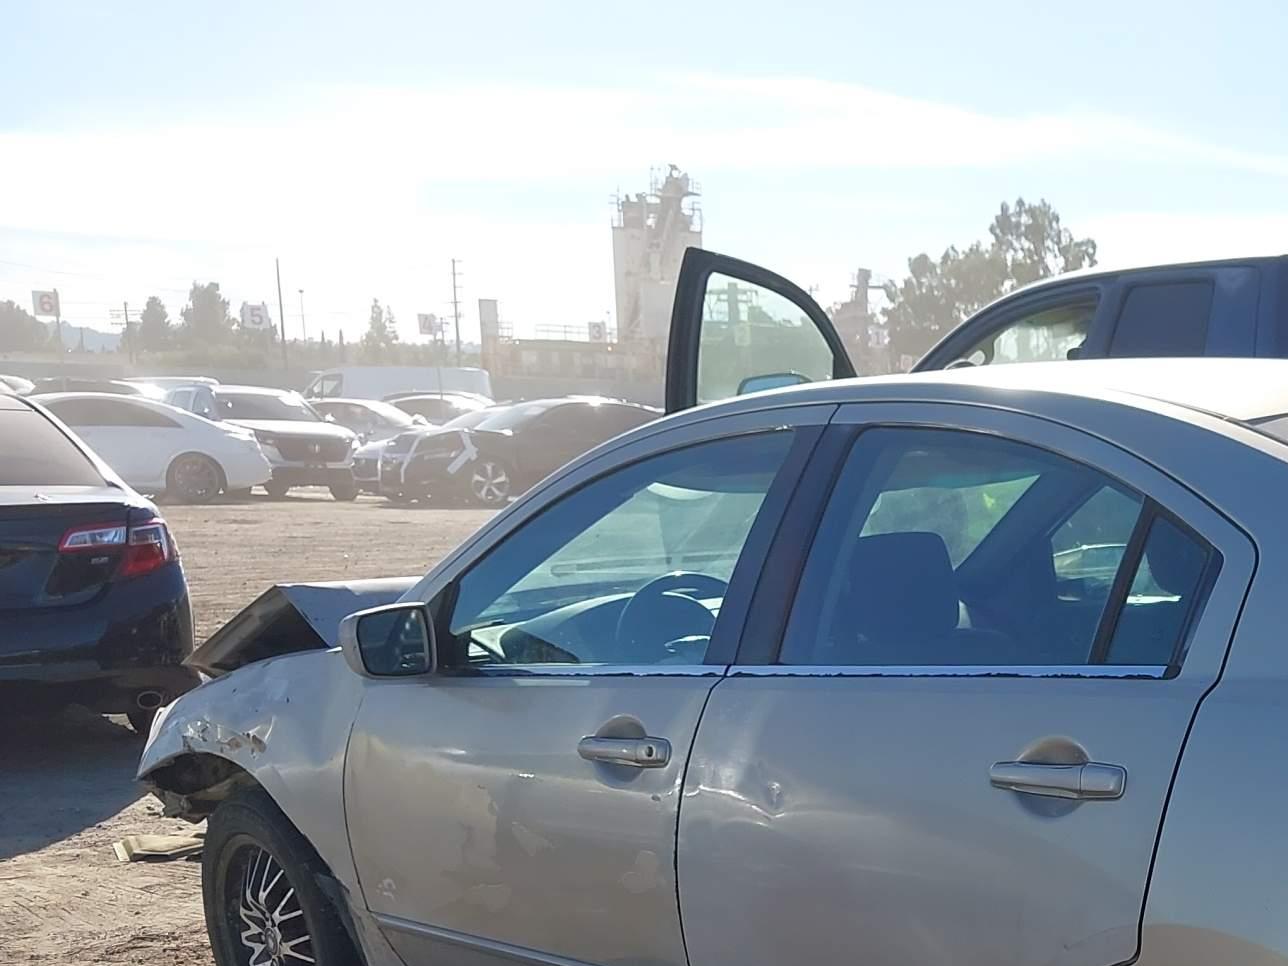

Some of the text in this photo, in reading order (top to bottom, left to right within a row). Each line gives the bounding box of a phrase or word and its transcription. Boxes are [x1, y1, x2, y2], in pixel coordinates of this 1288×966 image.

[39, 294, 53, 312] 6
[250, 307, 263, 325] 5
[591, 324, 602, 340] 3
